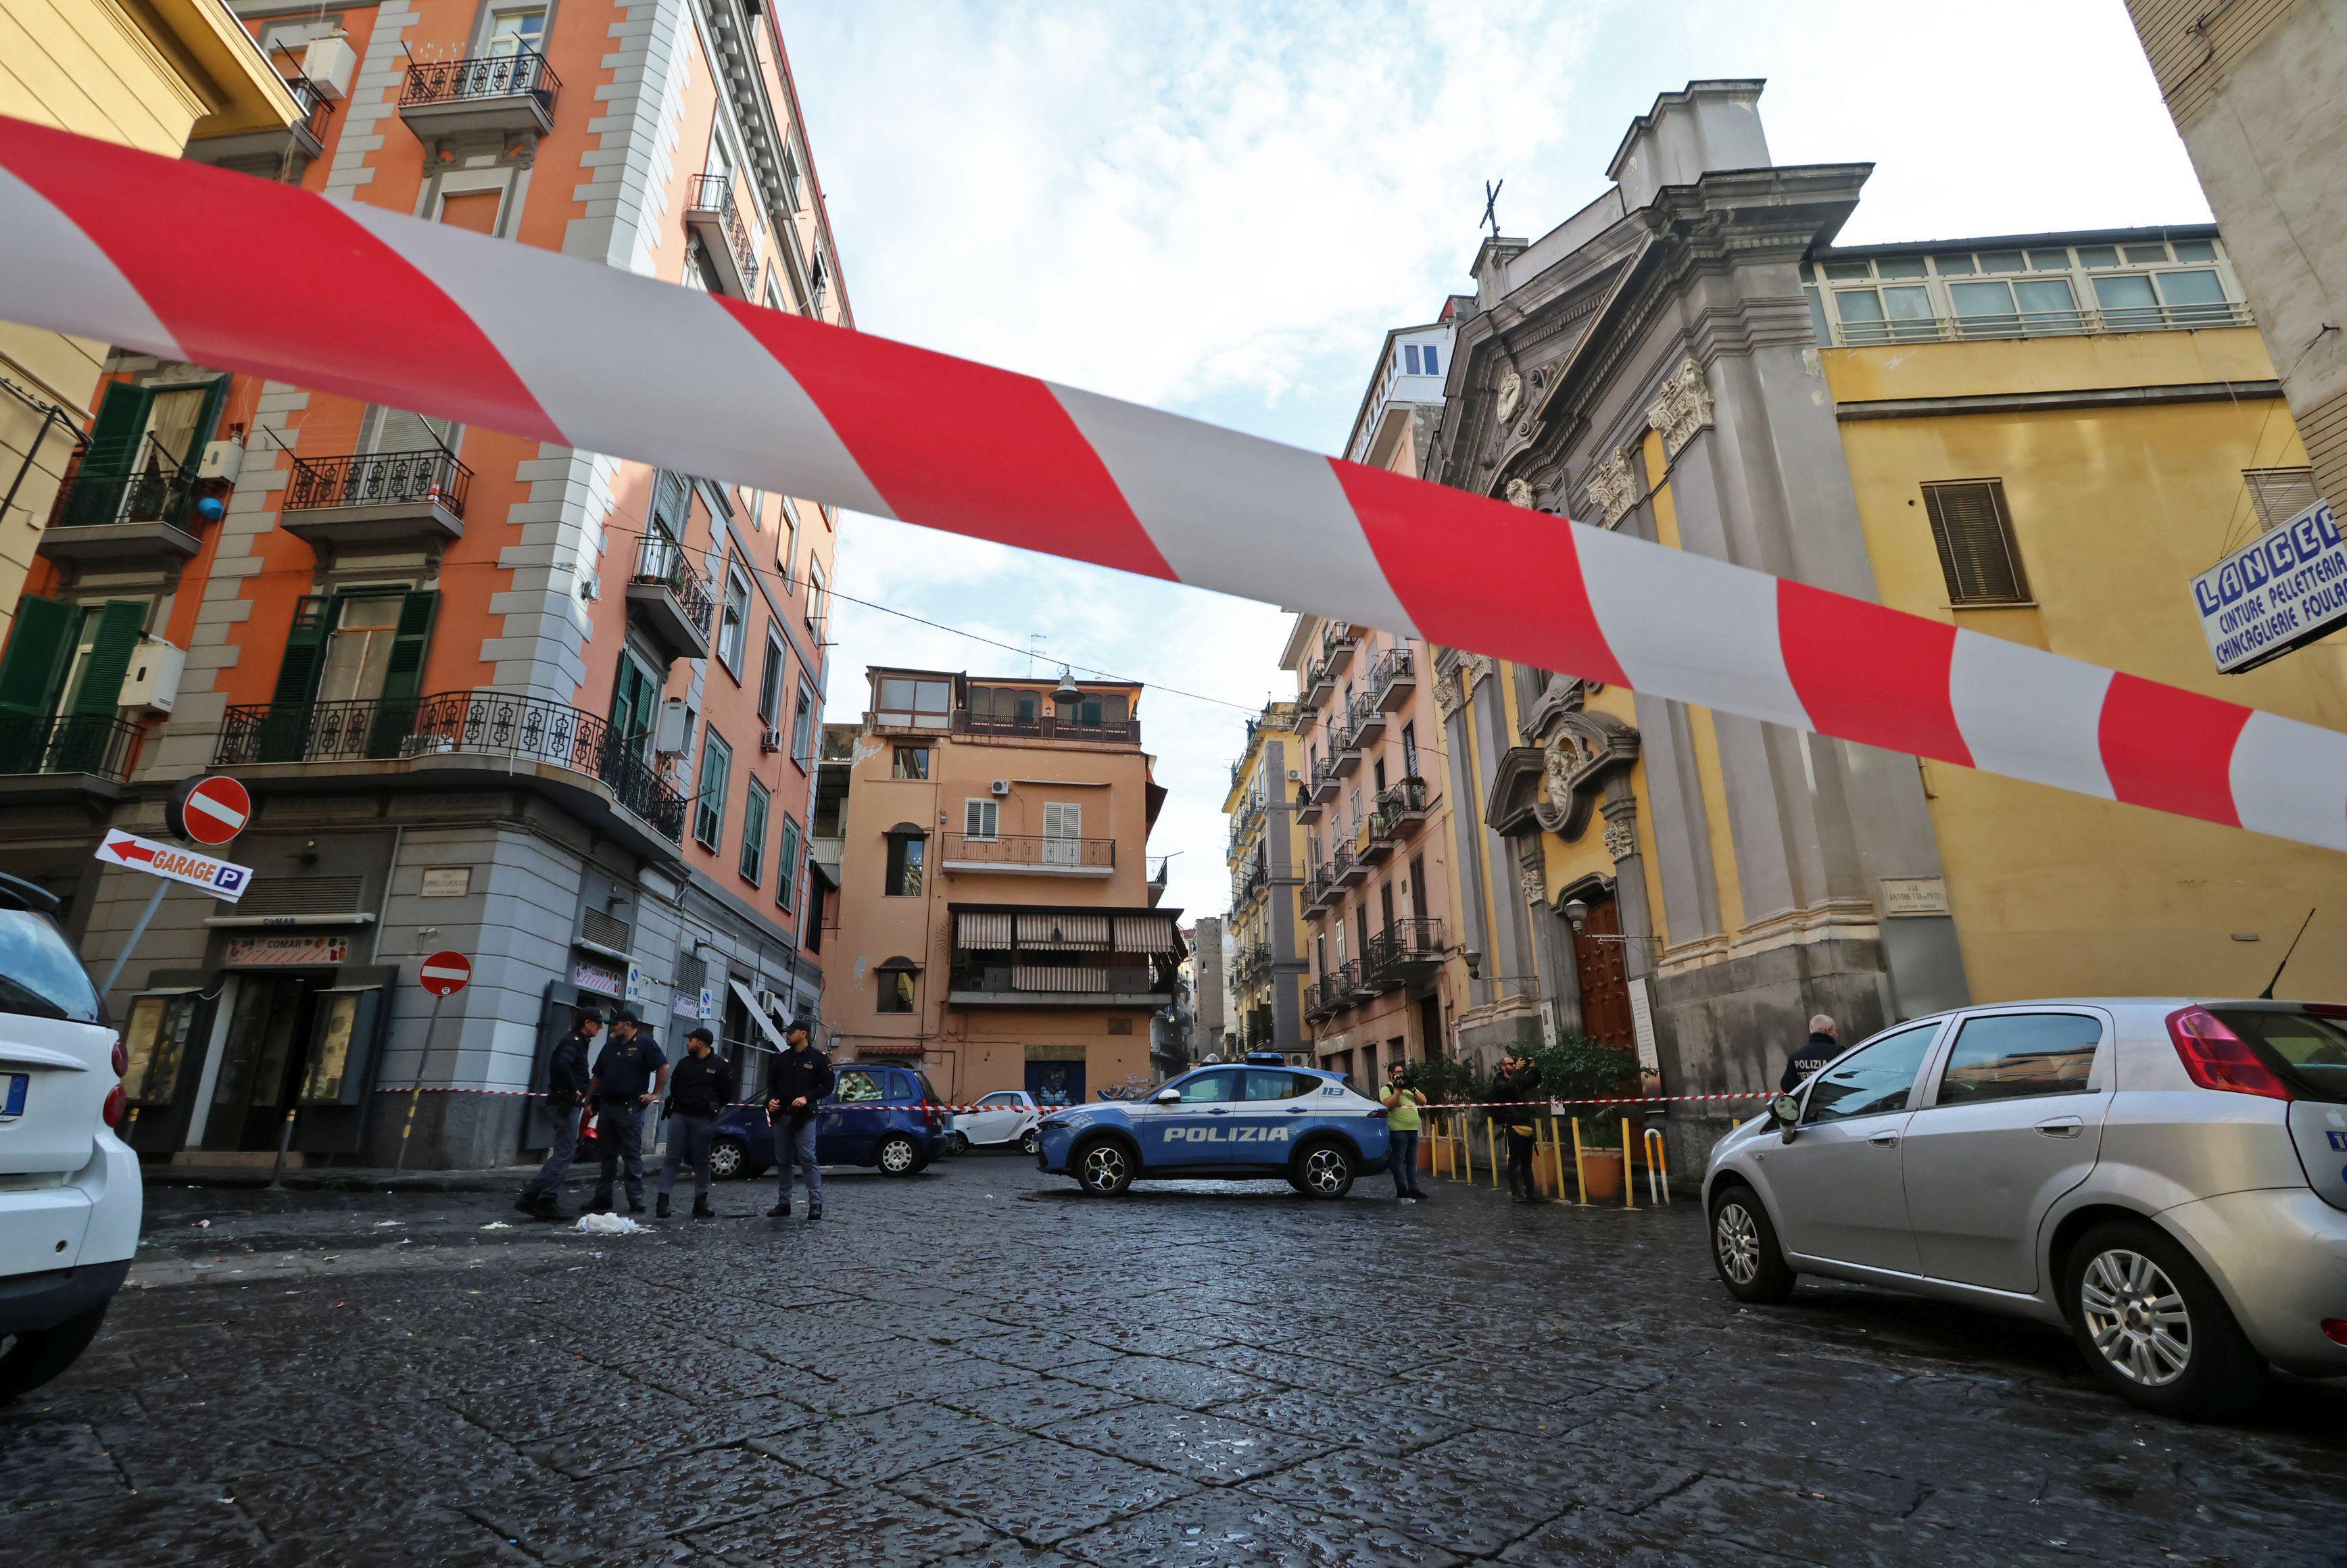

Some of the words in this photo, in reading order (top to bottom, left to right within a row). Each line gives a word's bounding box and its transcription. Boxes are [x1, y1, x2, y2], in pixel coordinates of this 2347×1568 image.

[2219, 595, 2265, 634] CINTURE
[2269, 551, 2347, 608] PELLETTERIA
[2217, 607, 2299, 664] CHINCAGLIERIE
[152, 850, 217, 882] GARAGE
[219, 869, 238, 885] P
[268, 939, 301, 948] COMAR
[1794, 1060, 1828, 1069] POLIZIA
[1322, 1087, 1345, 1096] 113
[1163, 1127, 1288, 1142] POLIZIA
